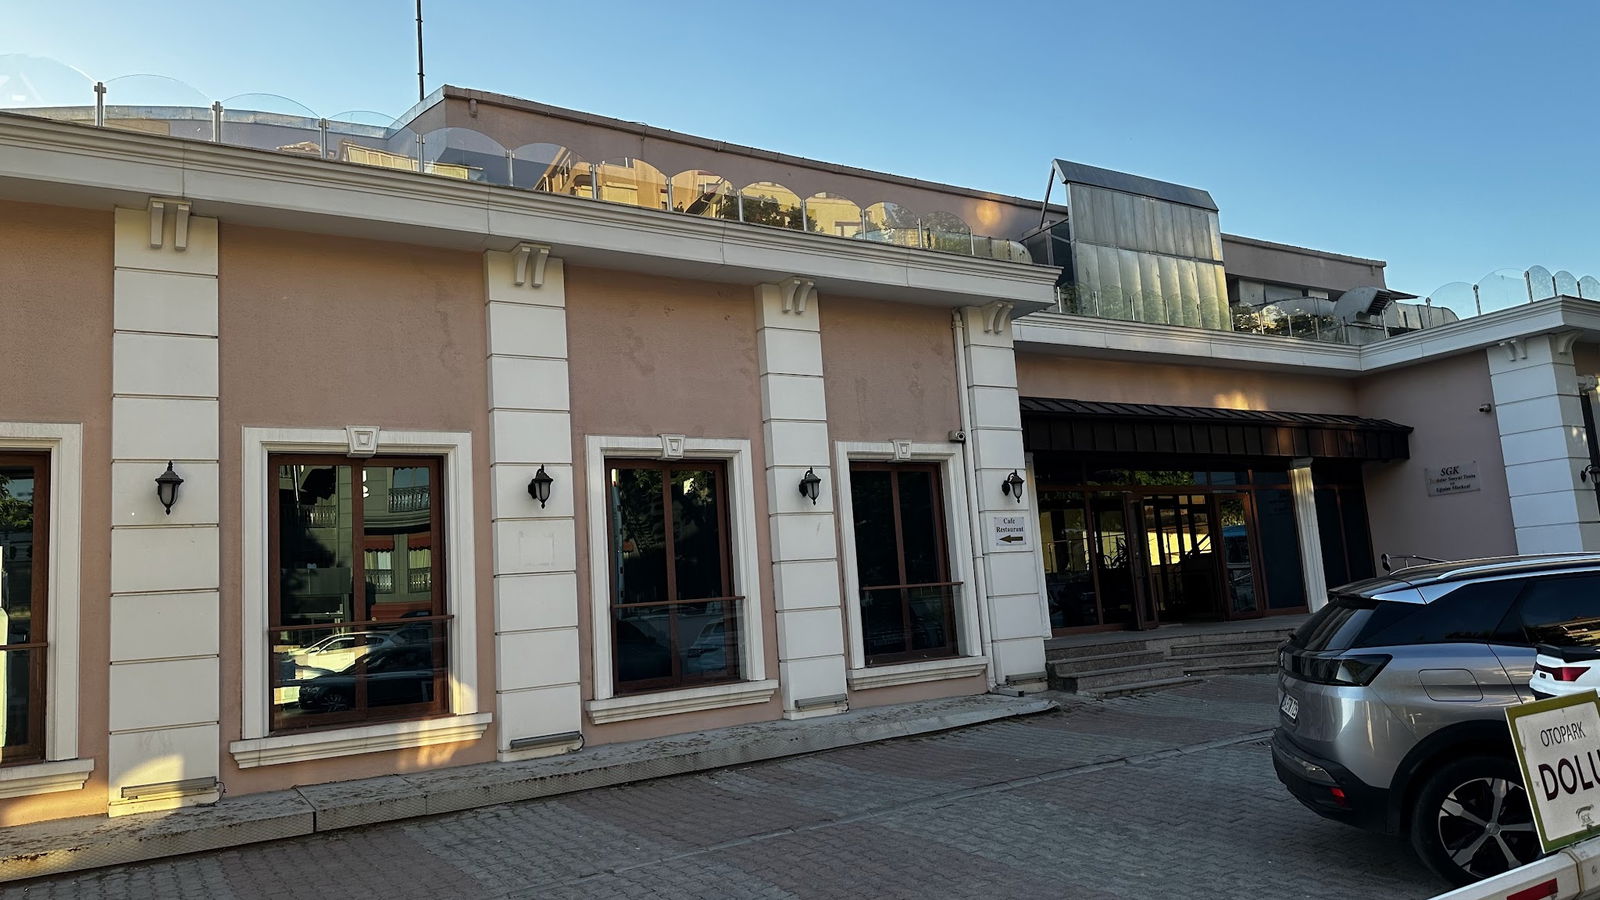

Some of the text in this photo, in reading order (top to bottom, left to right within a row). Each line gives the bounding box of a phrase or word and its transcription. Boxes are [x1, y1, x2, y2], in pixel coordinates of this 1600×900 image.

[1440, 465, 1460, 477] SGK
[1540, 721, 1586, 747] OTOPARK
[1538, 749, 1600, 801] DOLU
